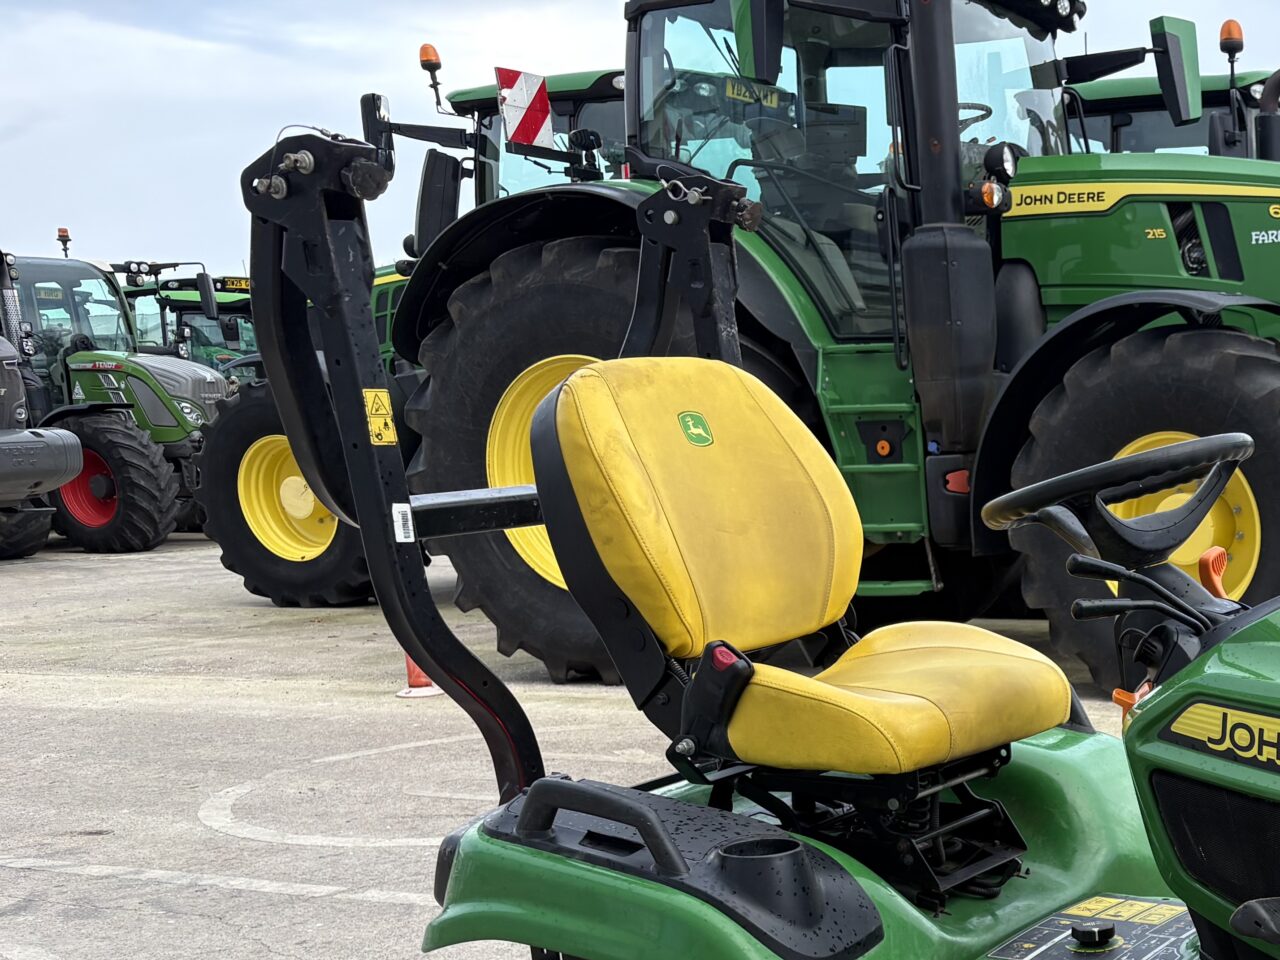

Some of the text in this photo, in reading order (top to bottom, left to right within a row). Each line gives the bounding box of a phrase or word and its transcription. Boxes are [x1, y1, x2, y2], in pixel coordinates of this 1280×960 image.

[1016, 191, 1106, 207] JOHN DEERE
[1144, 228, 1167, 240] 215
